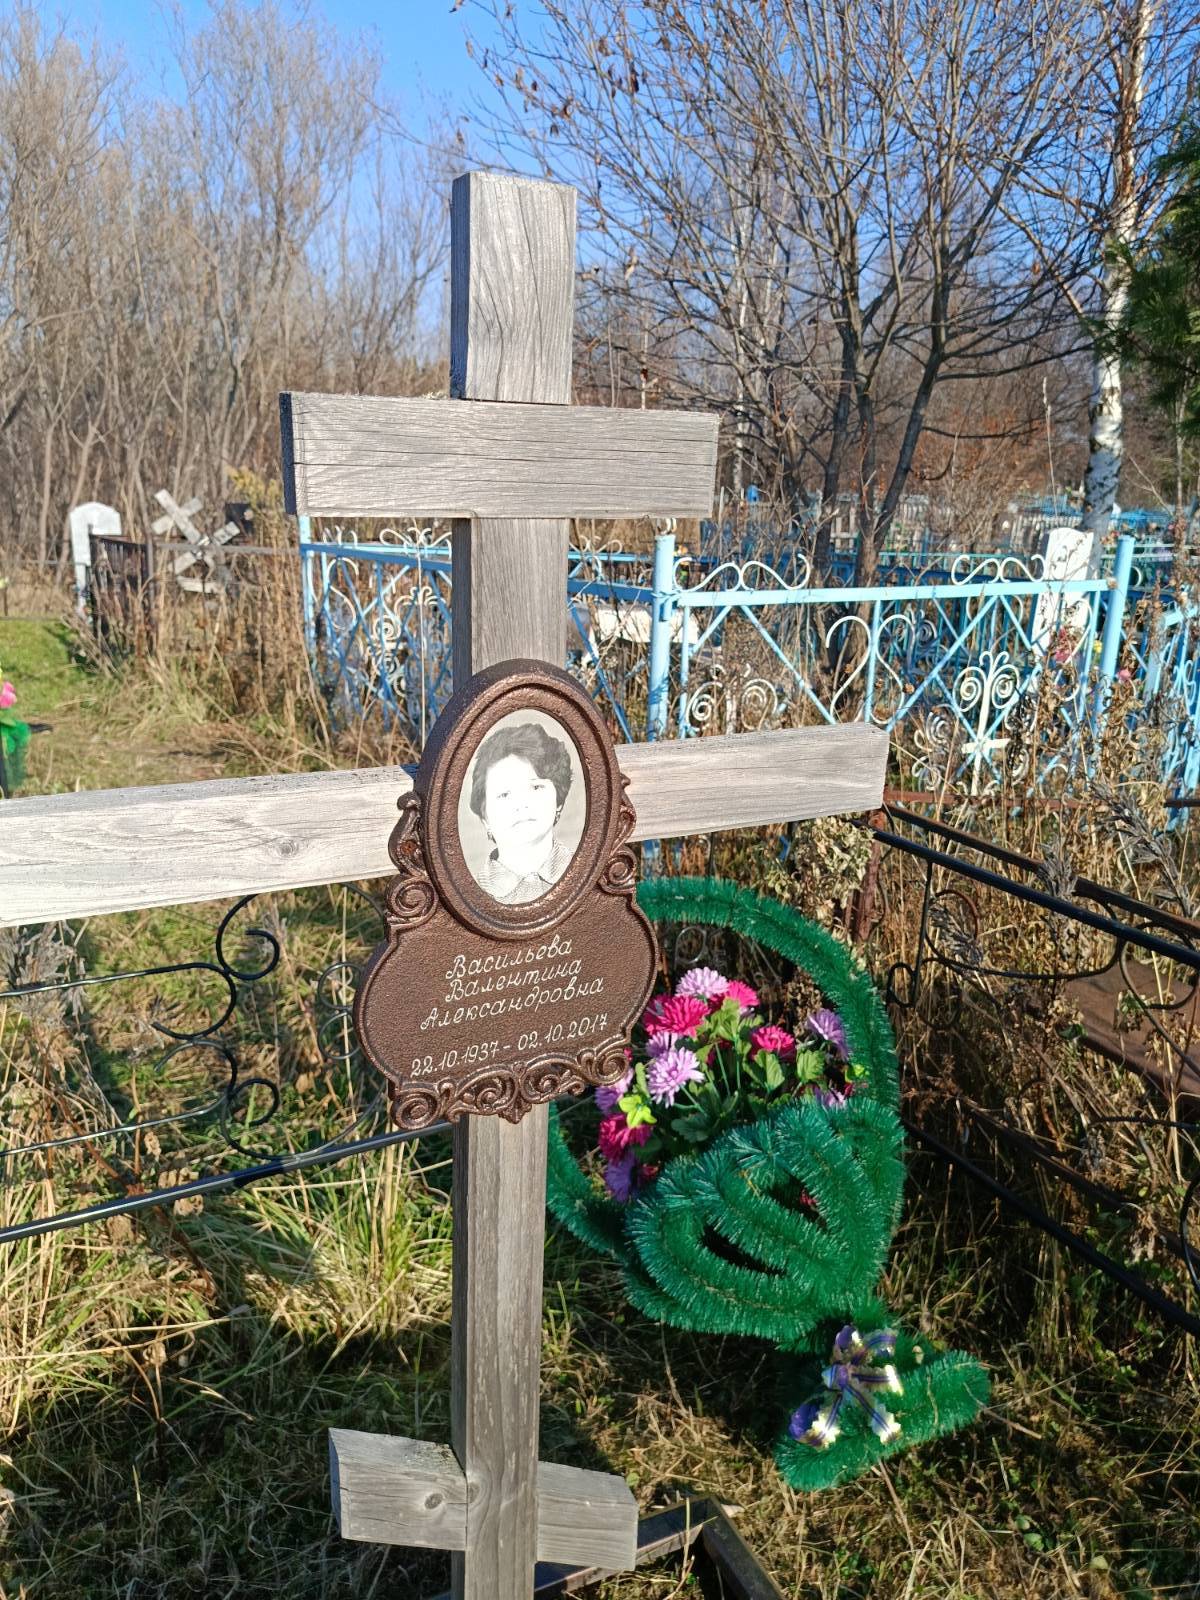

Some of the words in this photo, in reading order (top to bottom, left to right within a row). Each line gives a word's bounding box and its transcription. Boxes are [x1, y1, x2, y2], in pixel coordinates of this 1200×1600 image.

[444, 958, 582, 1003] Валентина
[445, 934, 573, 980] Васильева
[420, 977, 604, 1030] Александровна
[410, 1041, 499, 1078] 22.10.1937
[517, 1013, 608, 1051] 02.10.2017
